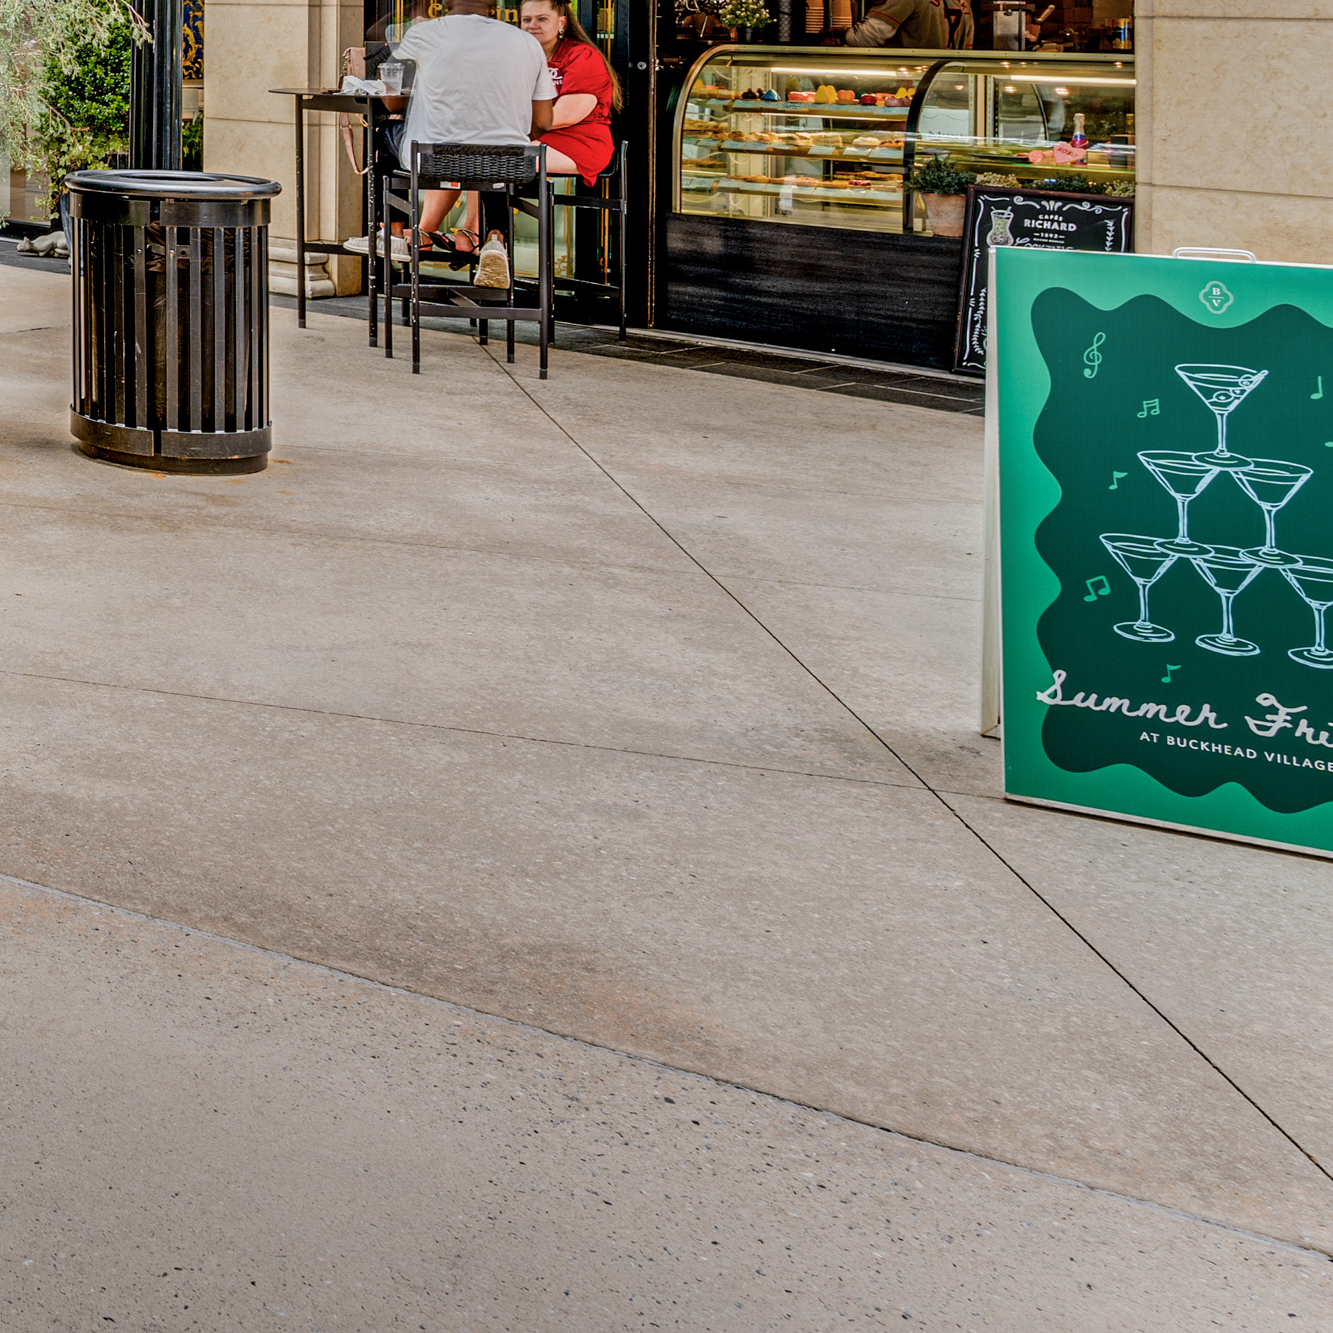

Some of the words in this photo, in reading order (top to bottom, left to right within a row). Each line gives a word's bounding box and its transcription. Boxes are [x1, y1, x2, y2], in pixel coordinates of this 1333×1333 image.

[1024, 218, 1077, 232] RICHARD
[1212, 287, 1221, 296] B
[1212, 299, 1221, 307] V
[1036, 669, 1229, 729] Summer
[1140, 731, 1160, 743] AT
[1166, 735, 1257, 759] BUCKHEAD
[1264, 751, 1333, 773] VILLAGE
